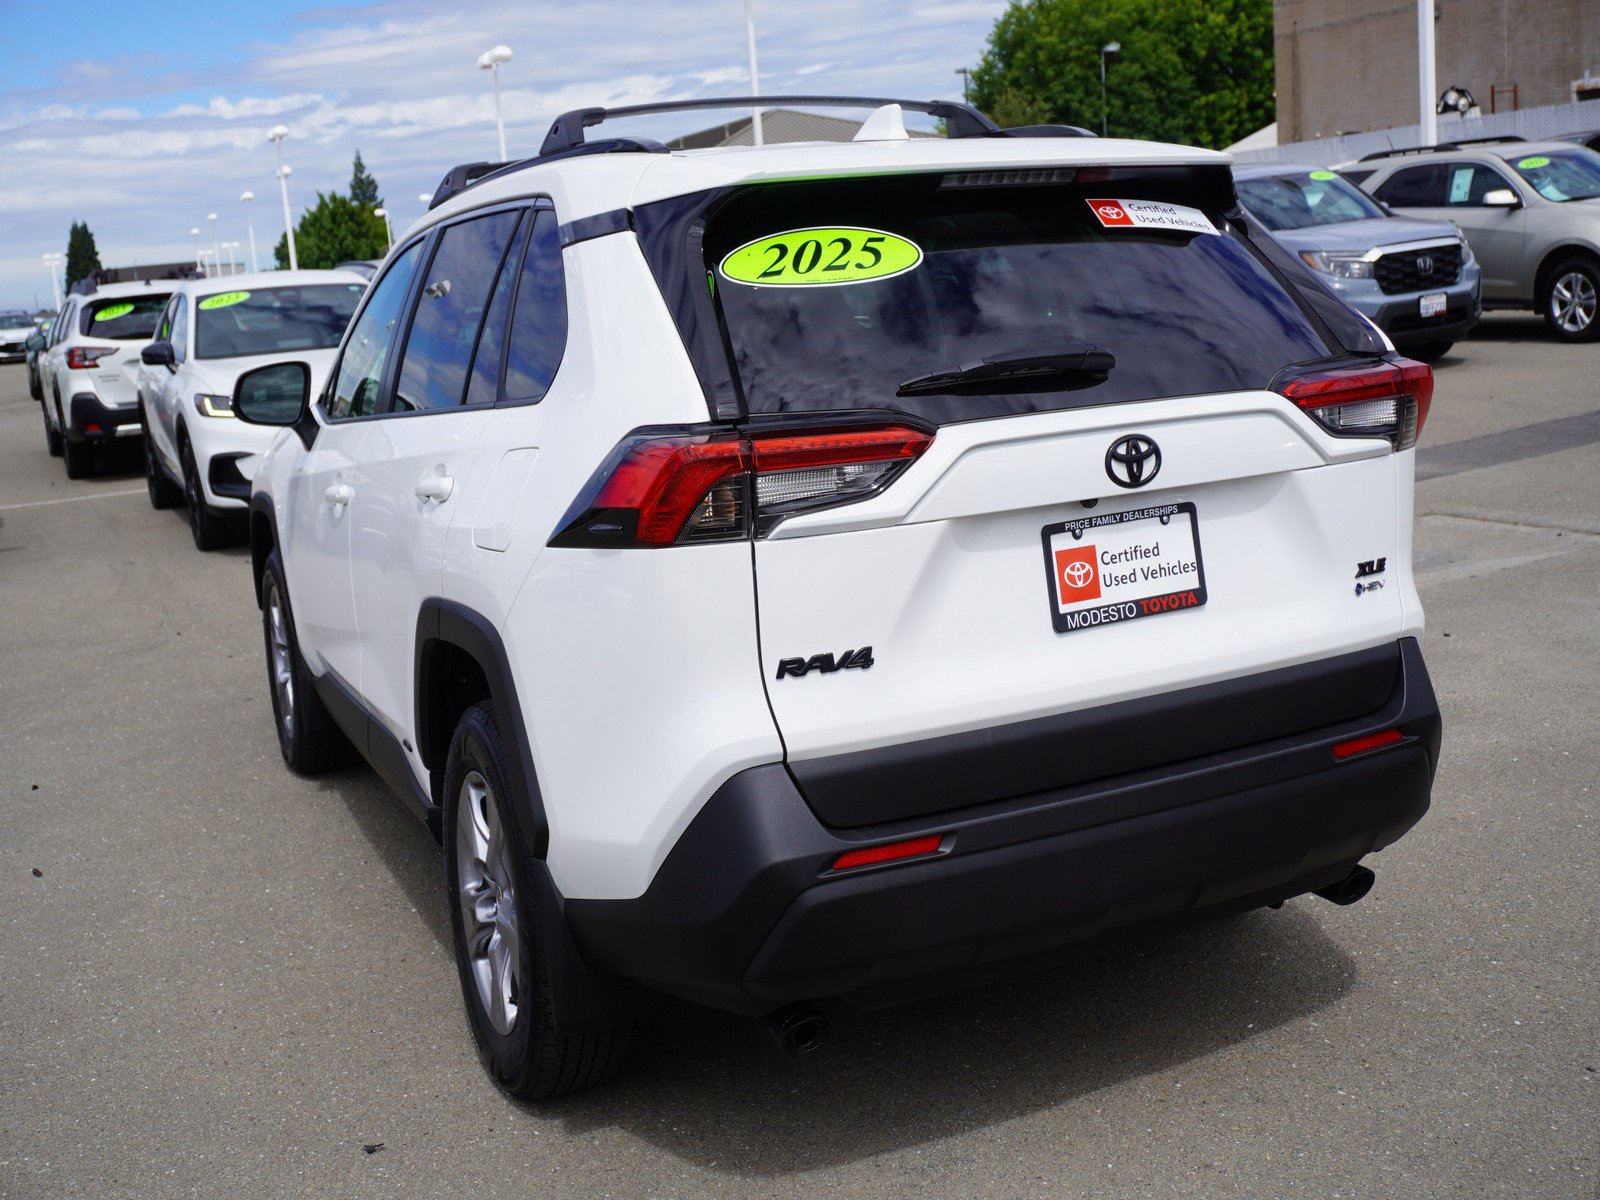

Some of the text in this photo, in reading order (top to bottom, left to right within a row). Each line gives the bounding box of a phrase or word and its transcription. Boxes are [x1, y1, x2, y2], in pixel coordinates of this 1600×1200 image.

[1128, 203, 1177, 215] Certified
[1135, 214, 1211, 231] Used Vehicles
[756, 236, 886, 280] 2025
[1064, 505, 1178, 531] PRICE FAMILY DEALERSHIPS
[1100, 542, 1160, 565] Certified
[1102, 559, 1197, 588] Used Vehicles
[1355, 557, 1387, 579] XLE
[1066, 591, 1198, 629] MODESTO TOYOTA
[775, 645, 875, 680] RAV4
